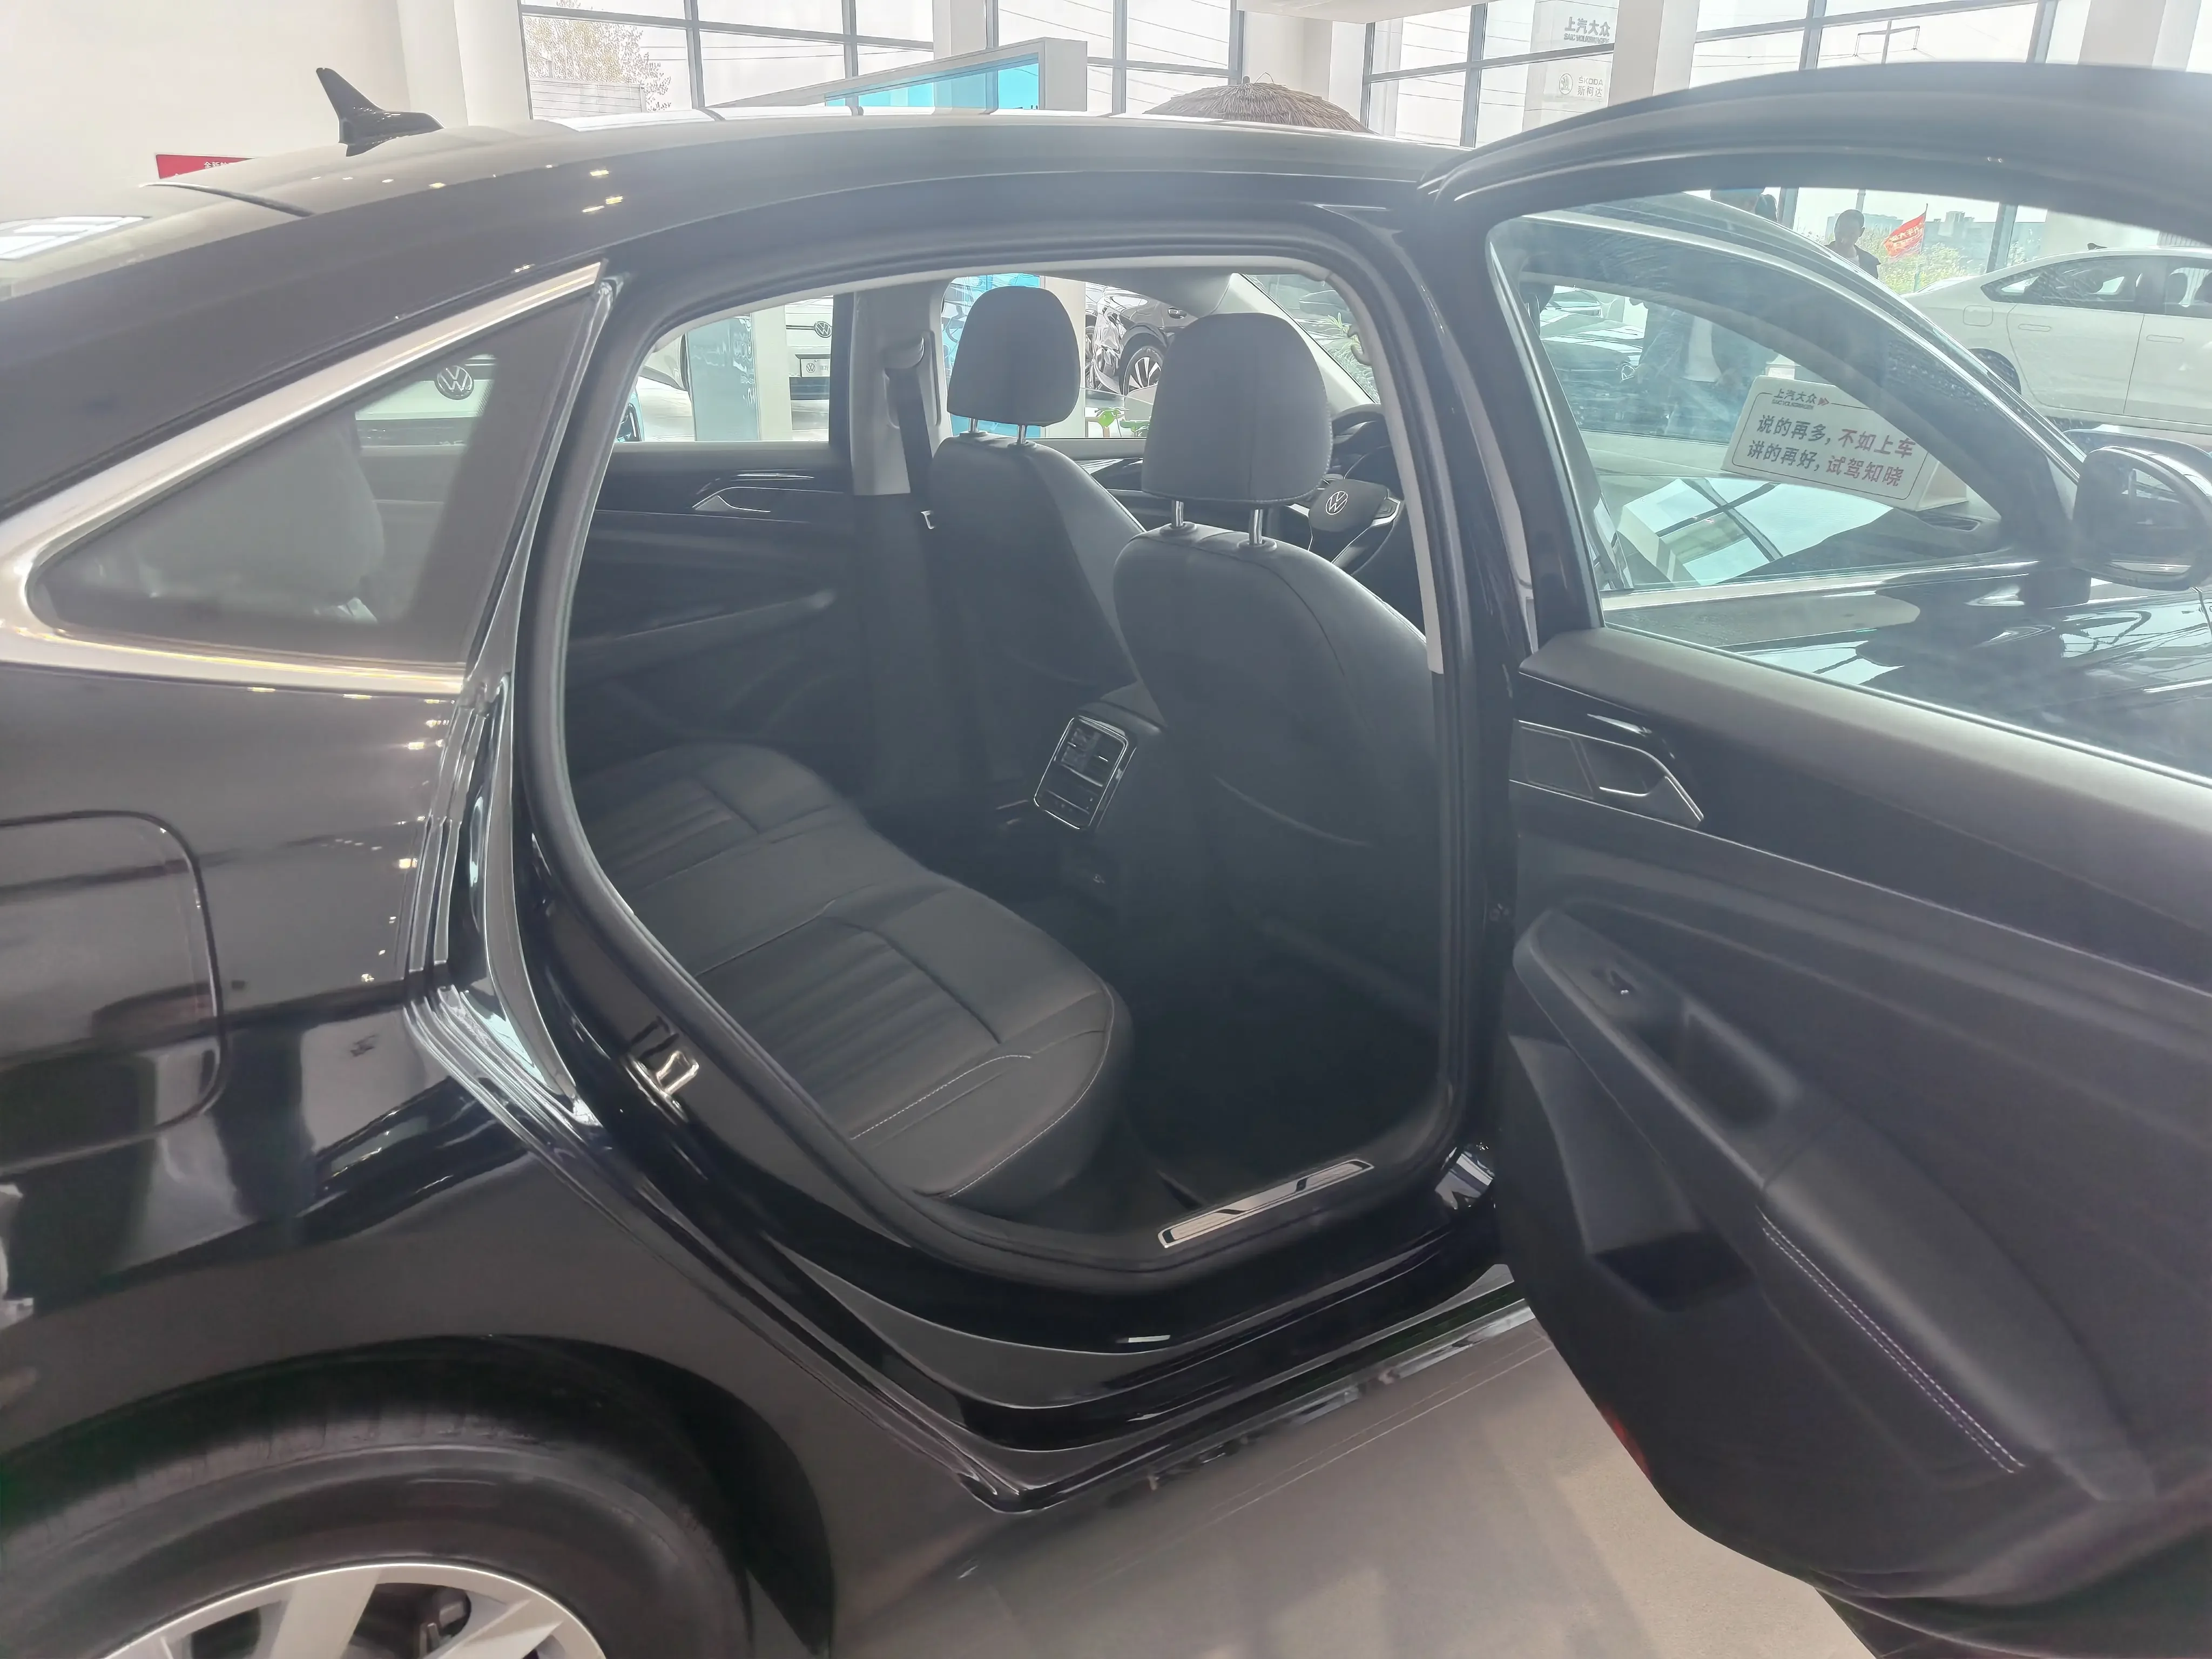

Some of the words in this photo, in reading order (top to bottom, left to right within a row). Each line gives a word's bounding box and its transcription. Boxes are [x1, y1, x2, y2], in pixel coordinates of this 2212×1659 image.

[1564, 16, 1610, 37] 上汽大众
[1577, 86, 1602, 97] 斯柯达
[1773, 388, 1817, 404] 上汽大众
[1756, 414, 1916, 458] 说的再多，不如上车
[1747, 440, 1904, 486] 讲的再好，试驾知晓
